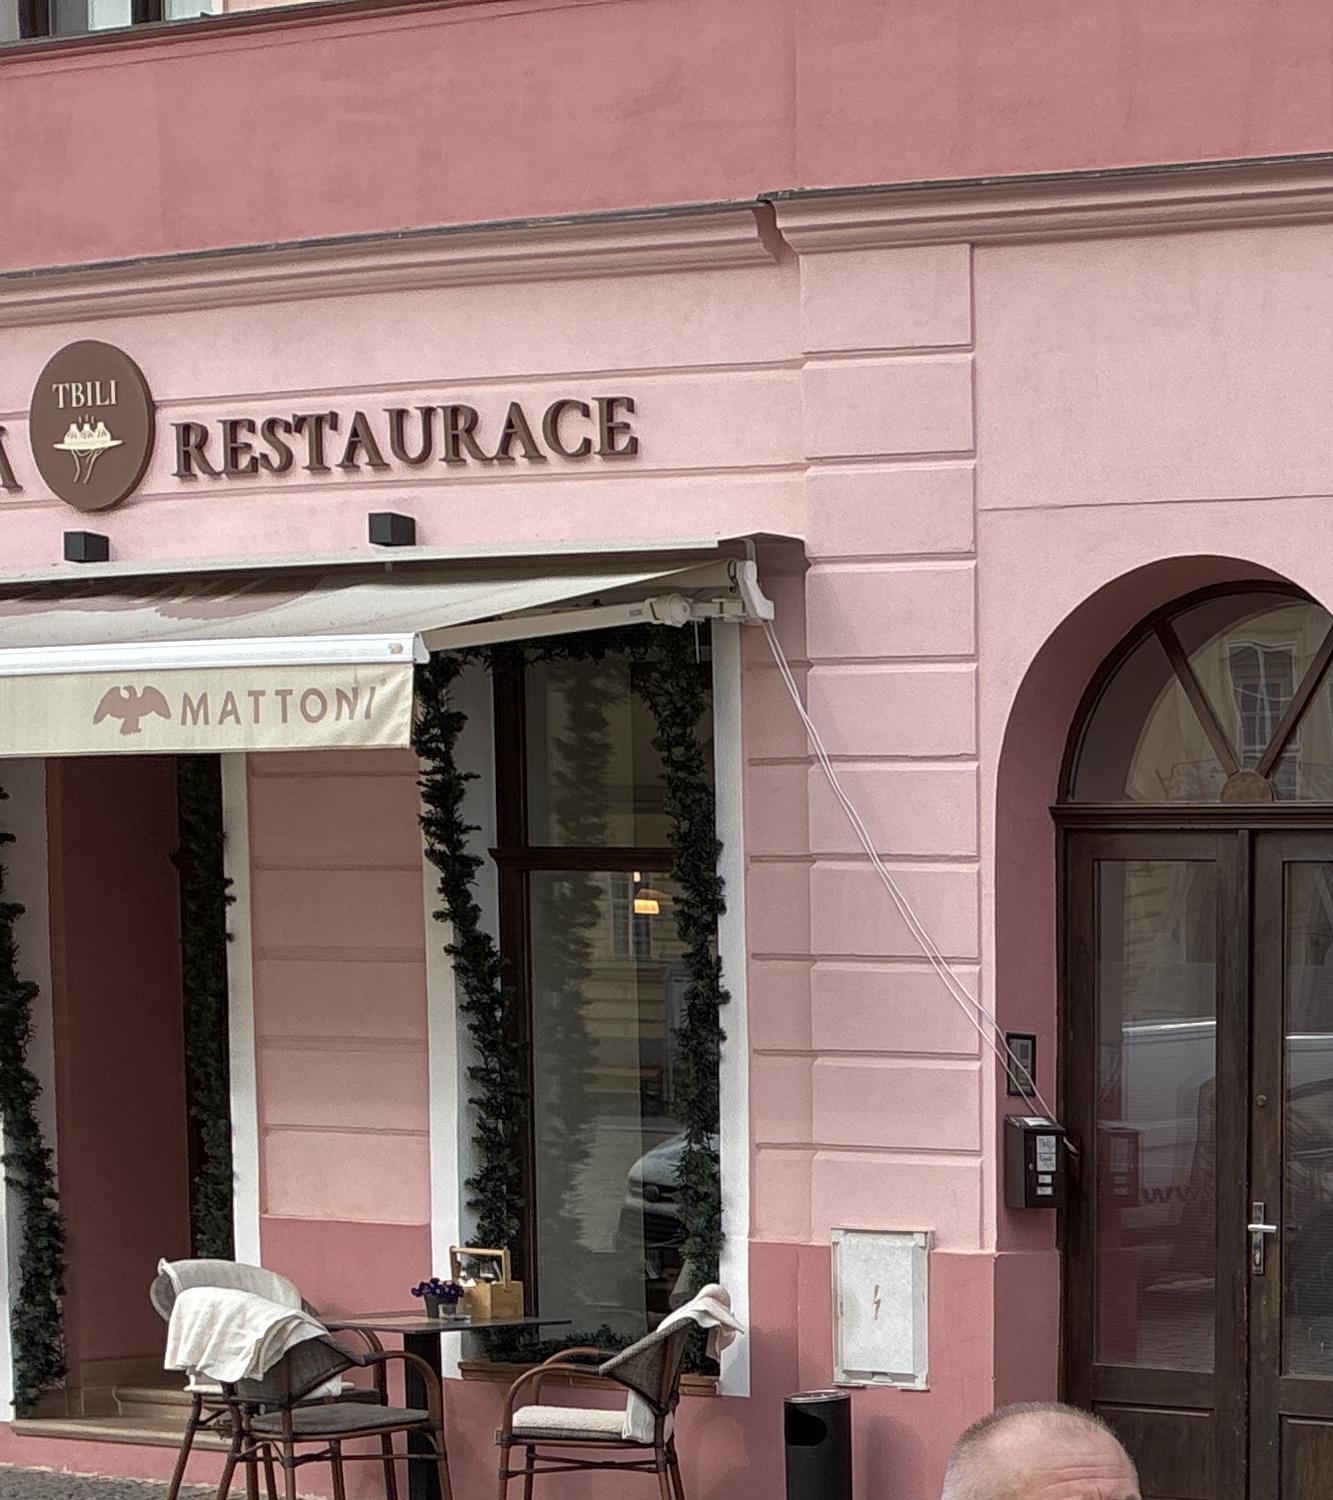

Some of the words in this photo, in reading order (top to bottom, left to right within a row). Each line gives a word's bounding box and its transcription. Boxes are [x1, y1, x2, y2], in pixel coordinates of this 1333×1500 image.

[52, 380, 117, 409] TBILI
[171, 396, 638, 479] RESTAURACE
[181, 686, 376, 727] MATTONI
